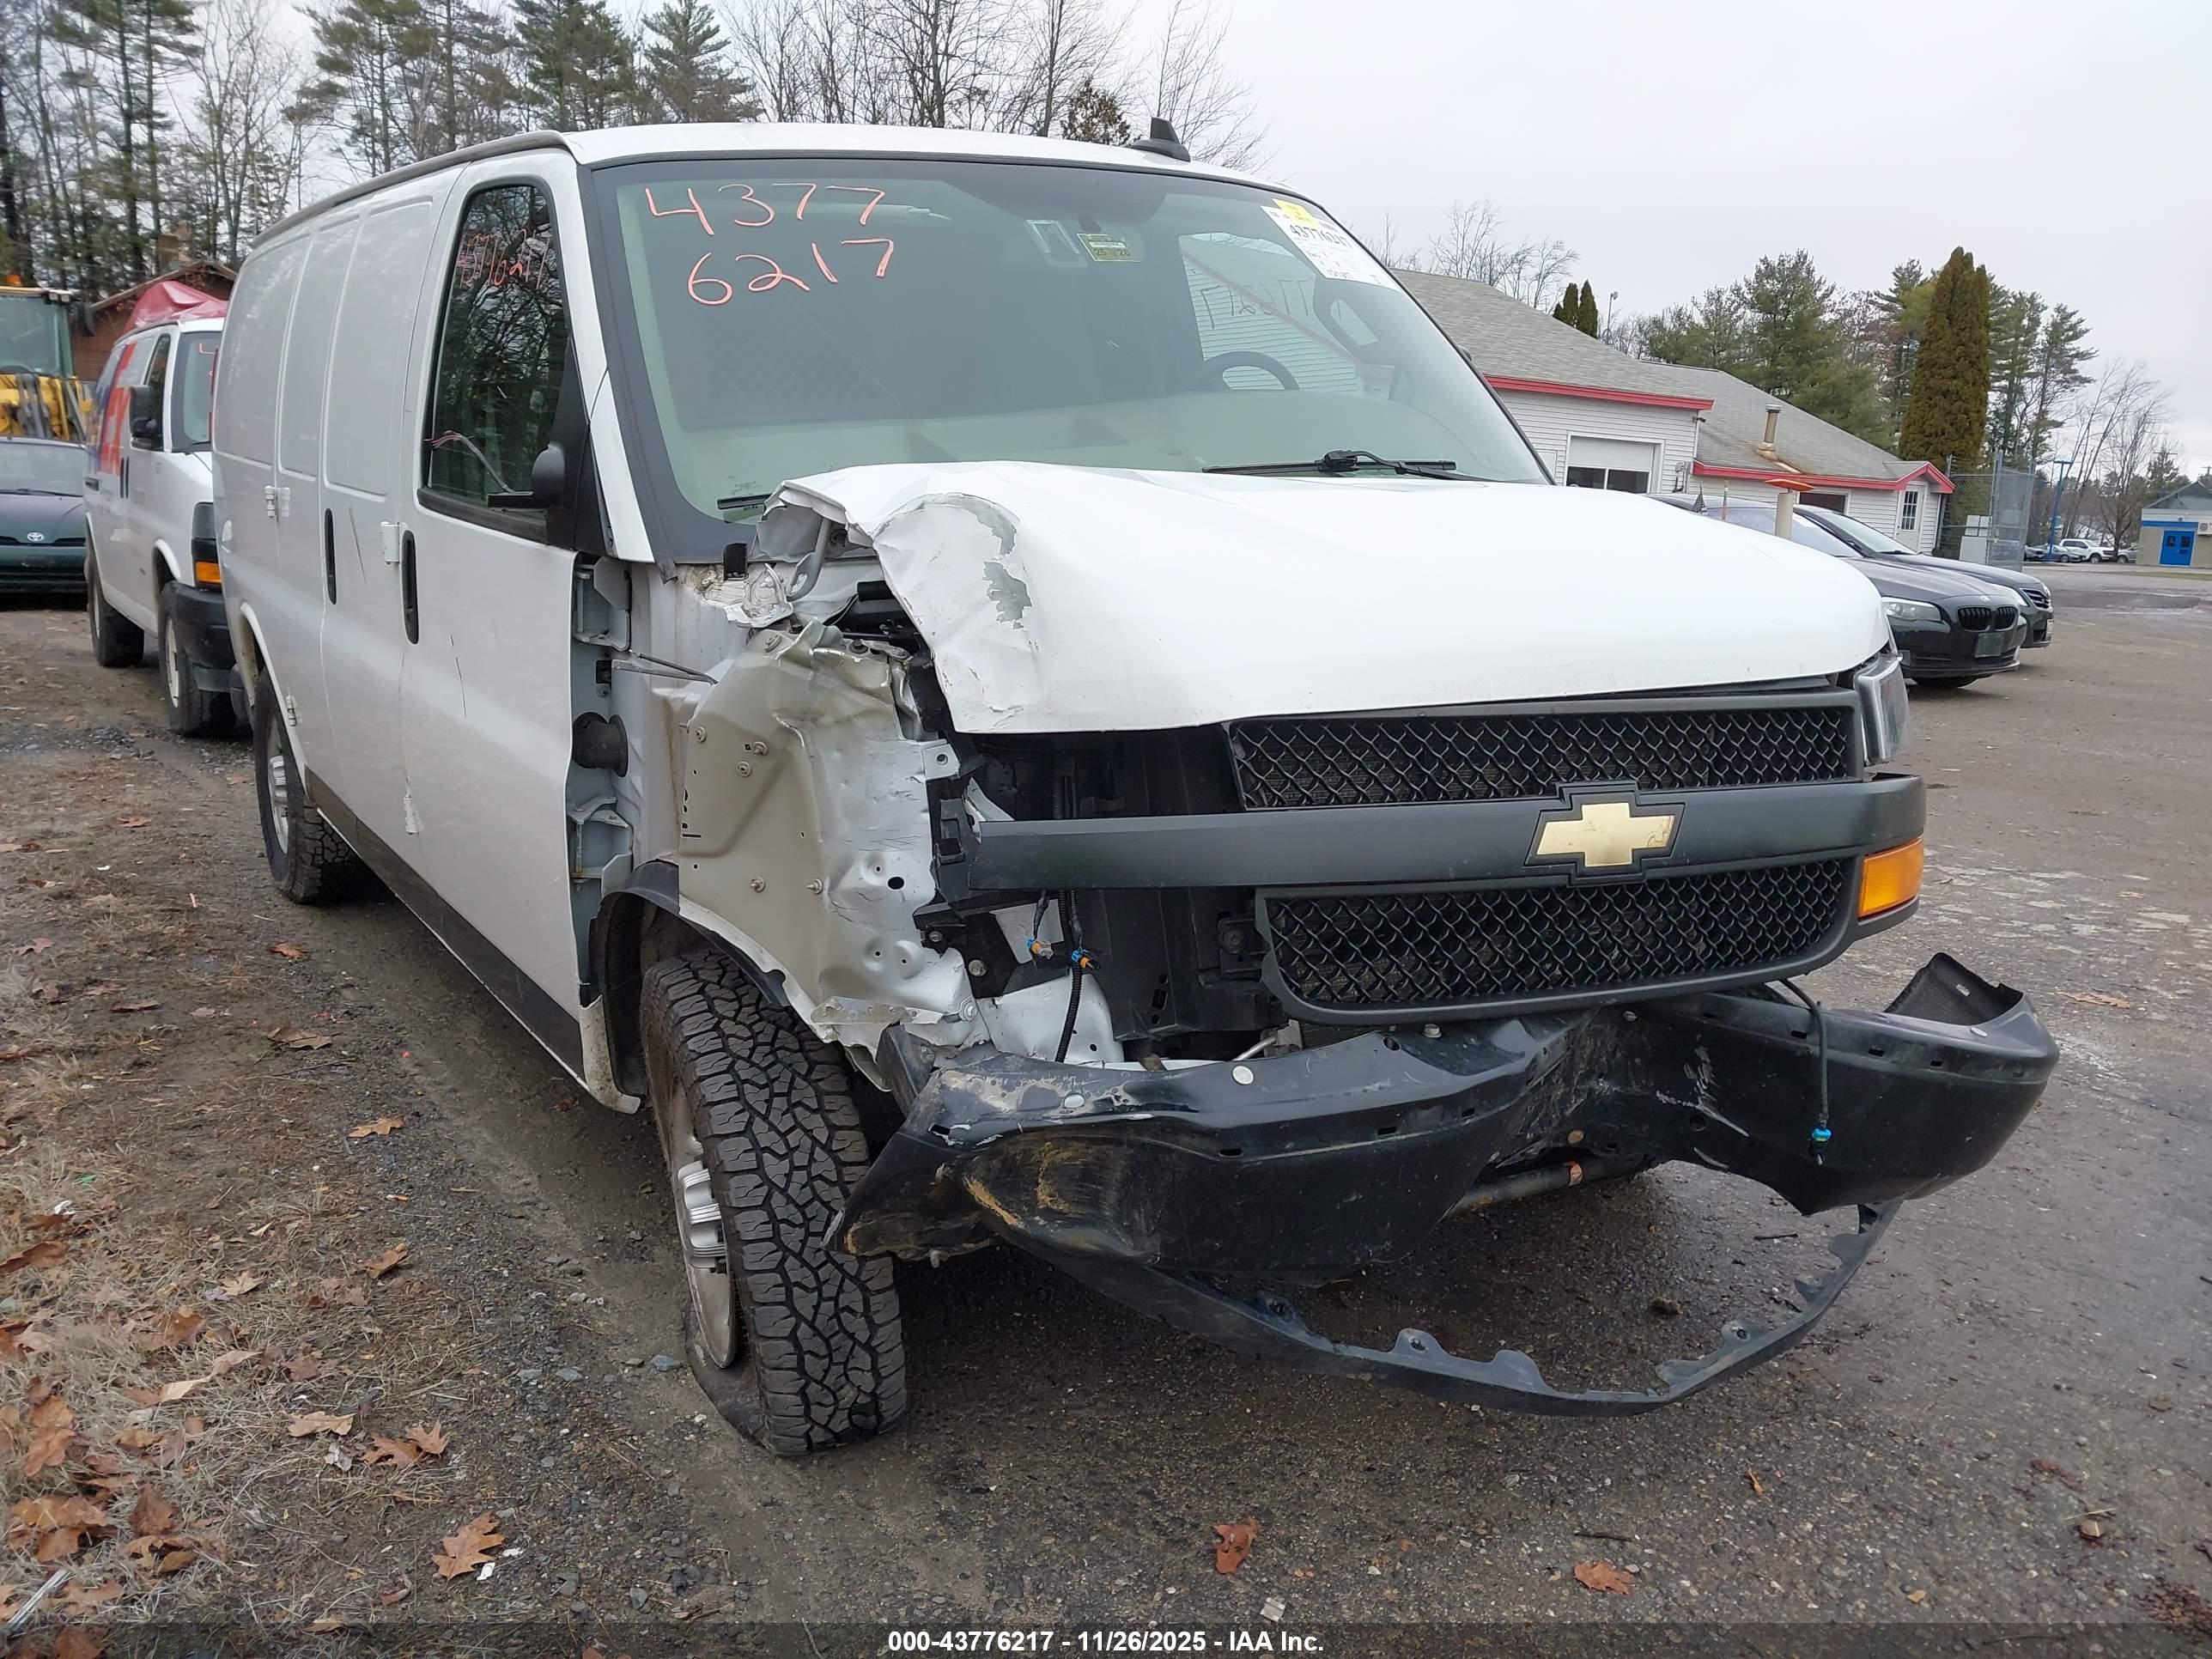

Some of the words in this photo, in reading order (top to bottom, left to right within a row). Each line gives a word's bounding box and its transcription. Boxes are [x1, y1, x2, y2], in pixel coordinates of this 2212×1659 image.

[645, 183, 885, 235] 4377
[1290, 223, 1354, 249] 43776217
[688, 238, 894, 306] 6217
